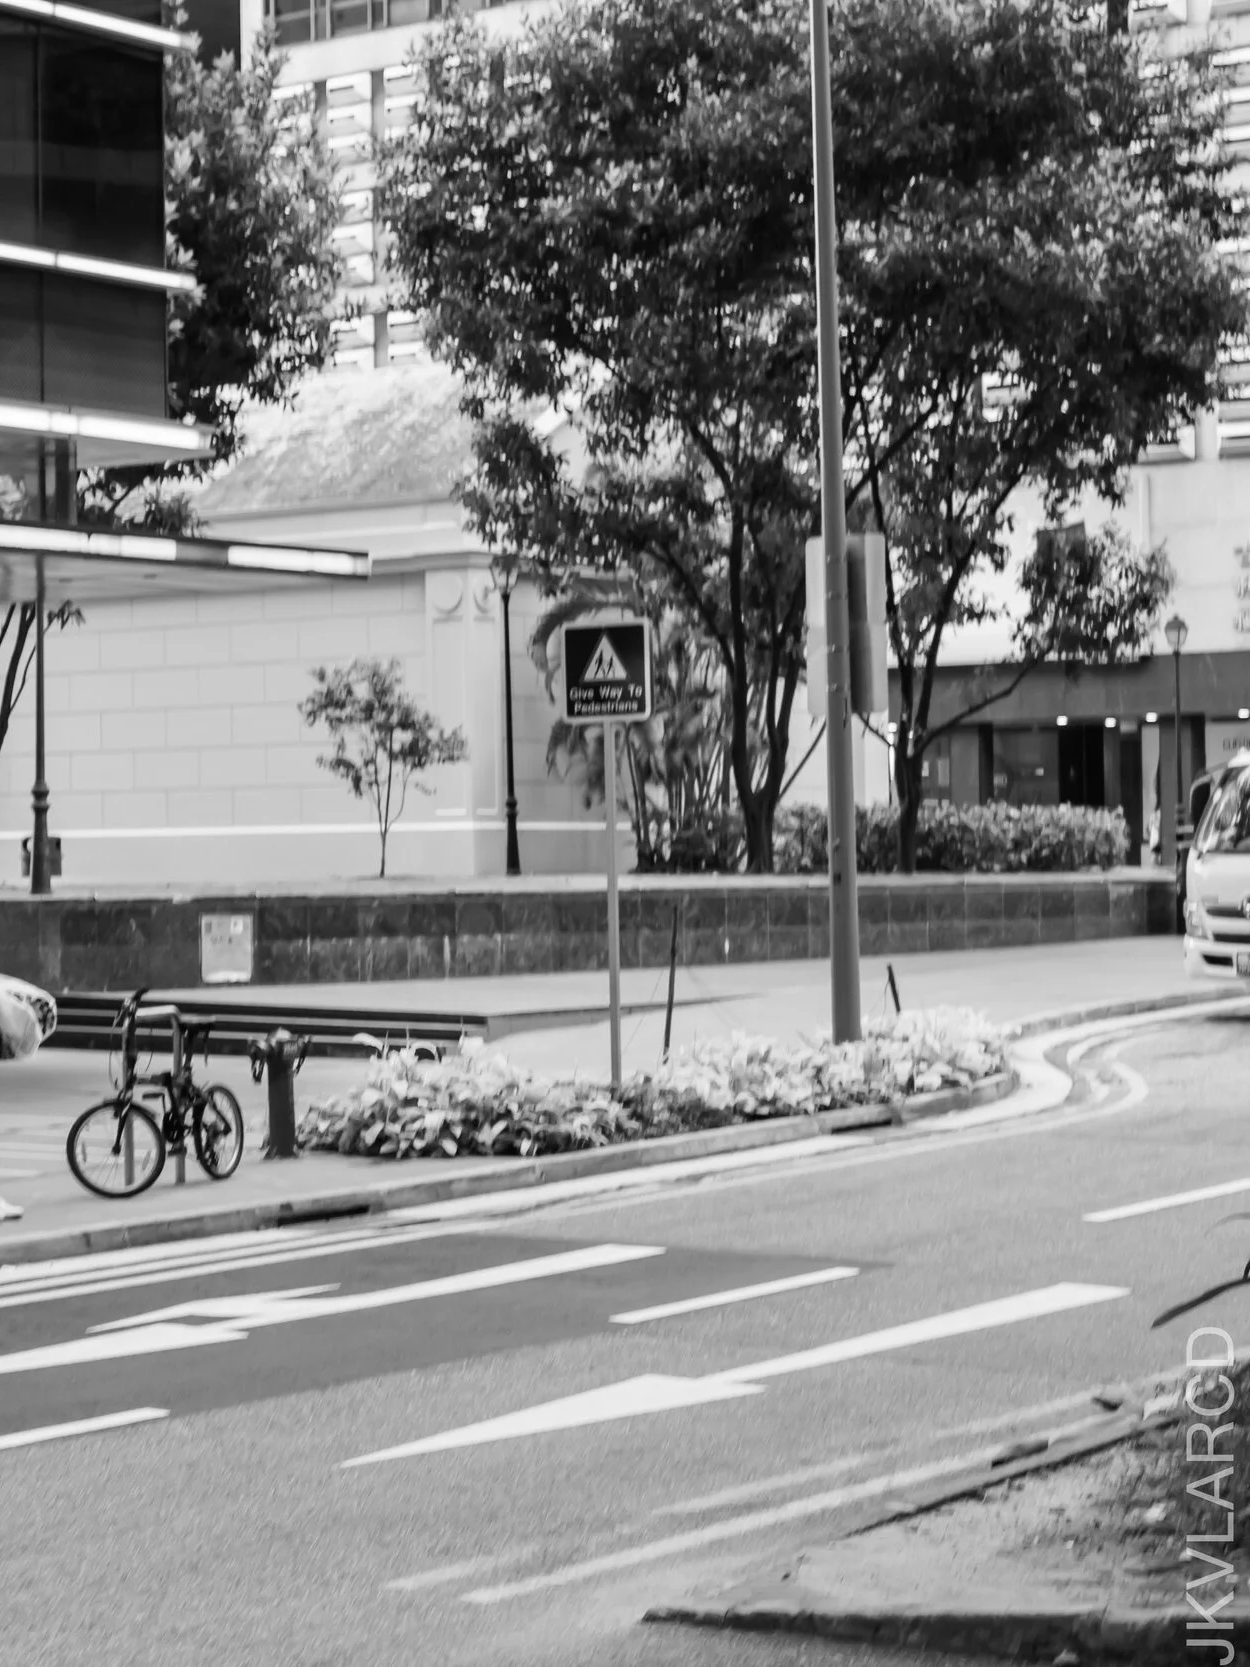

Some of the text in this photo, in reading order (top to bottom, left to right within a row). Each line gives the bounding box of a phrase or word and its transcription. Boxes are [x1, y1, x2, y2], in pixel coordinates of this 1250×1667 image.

[570, 683, 643, 702] Give Way To
